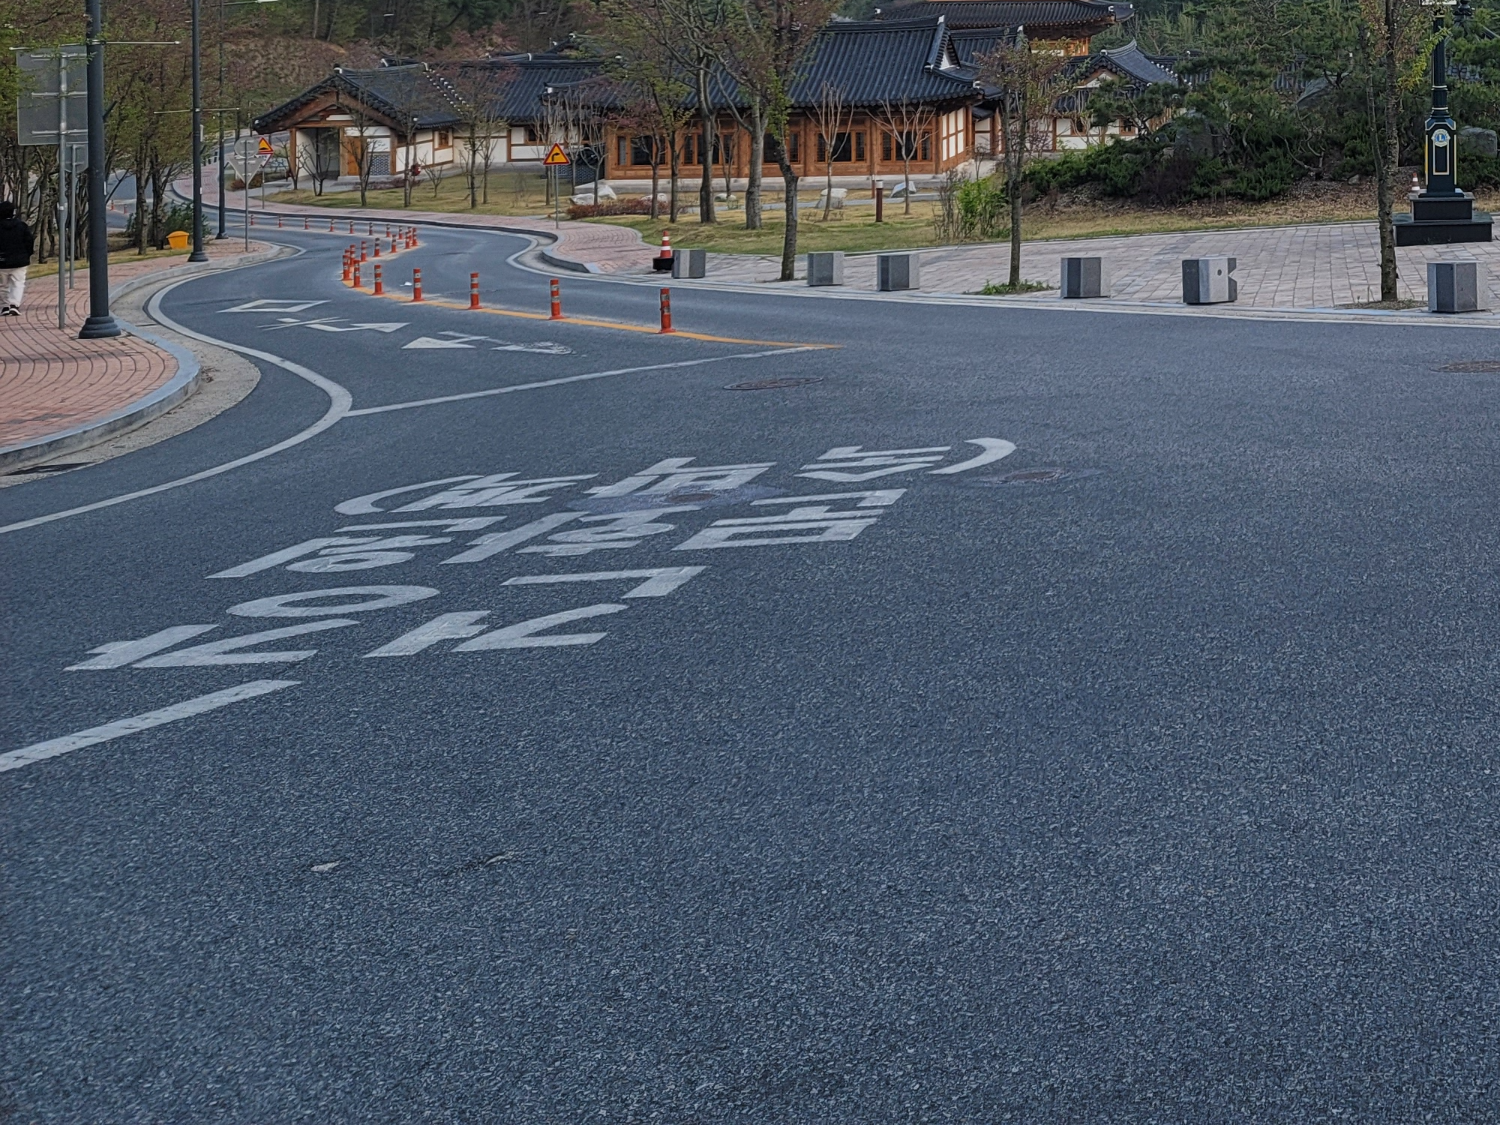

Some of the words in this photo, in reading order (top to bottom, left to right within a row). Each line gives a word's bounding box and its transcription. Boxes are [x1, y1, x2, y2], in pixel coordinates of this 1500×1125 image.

[333, 437, 1017, 515] (숙박객)
[203, 488, 908, 579] 문화원
[63, 565, 707, 671] 건강
